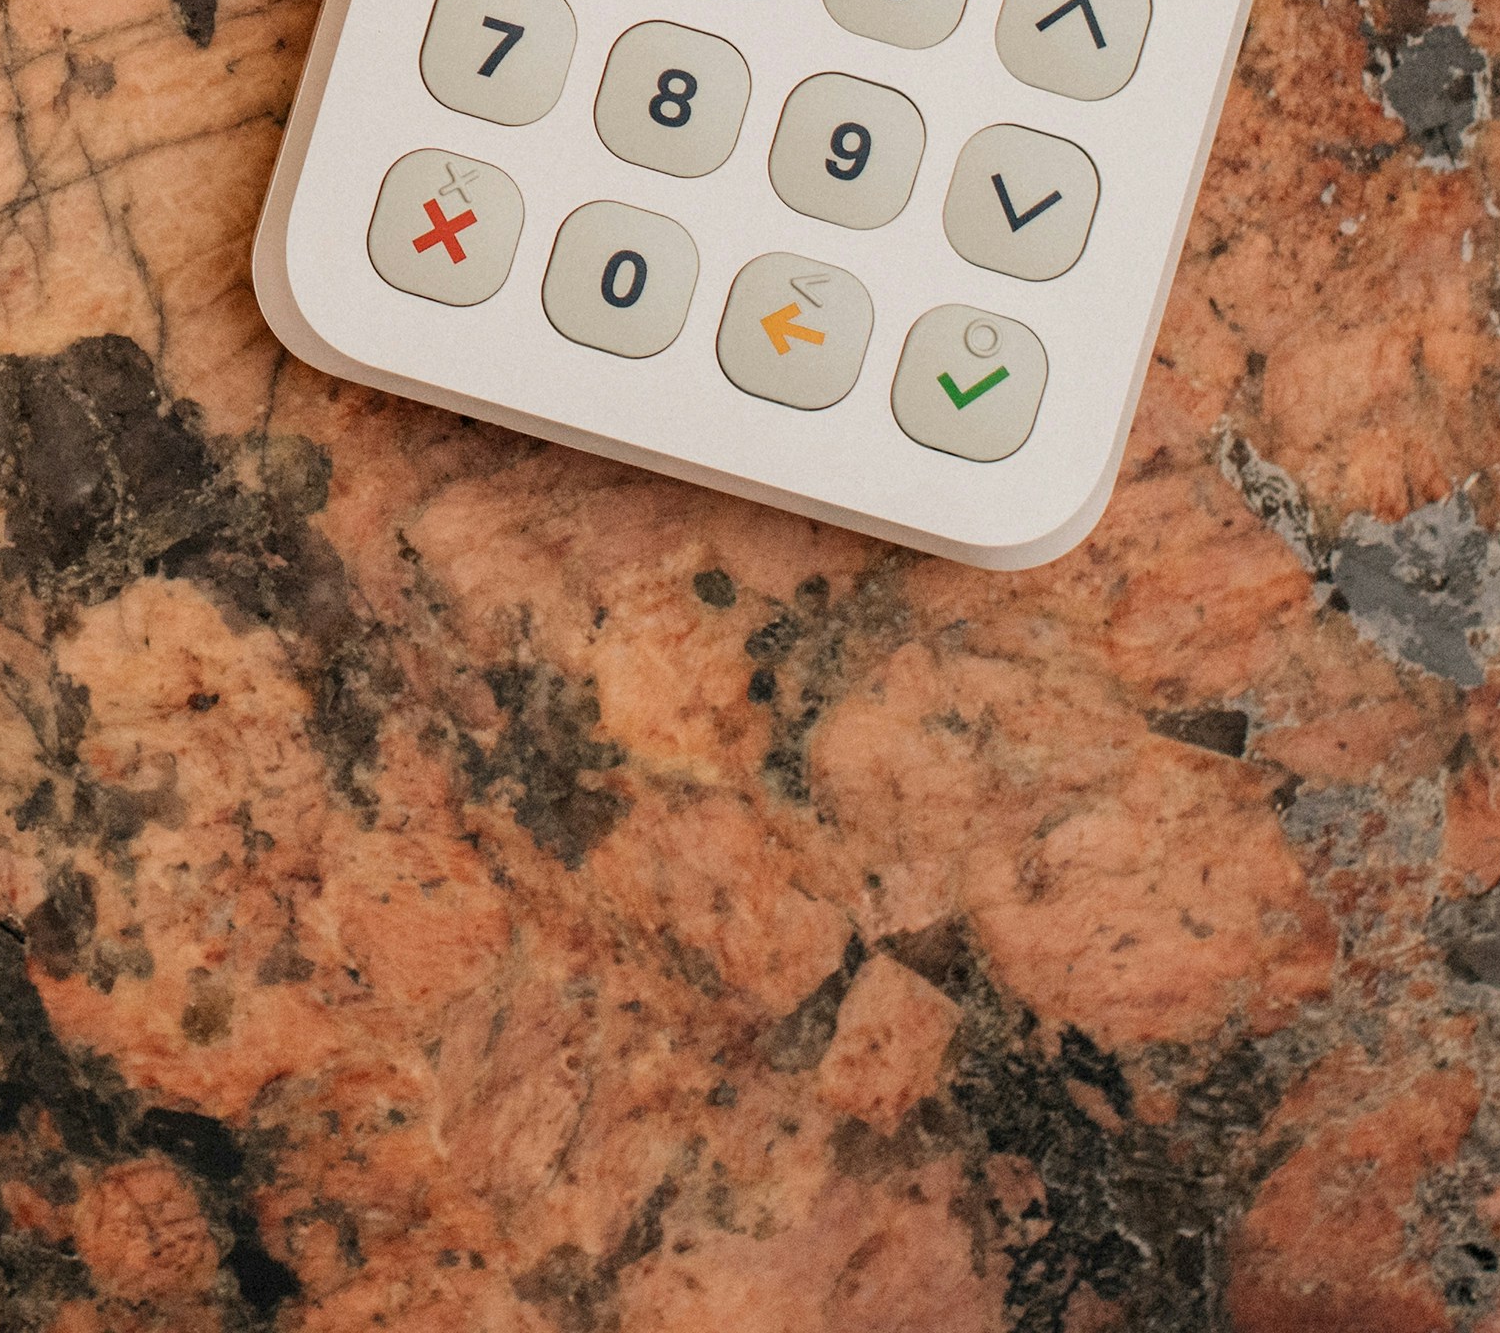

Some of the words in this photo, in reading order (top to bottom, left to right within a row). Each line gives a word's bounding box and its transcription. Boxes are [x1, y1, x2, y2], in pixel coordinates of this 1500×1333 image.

[476, 15, 526, 78] 7
[648, 68, 698, 128] 8
[824, 121, 872, 182] 9
[600, 249, 648, 309] 0
